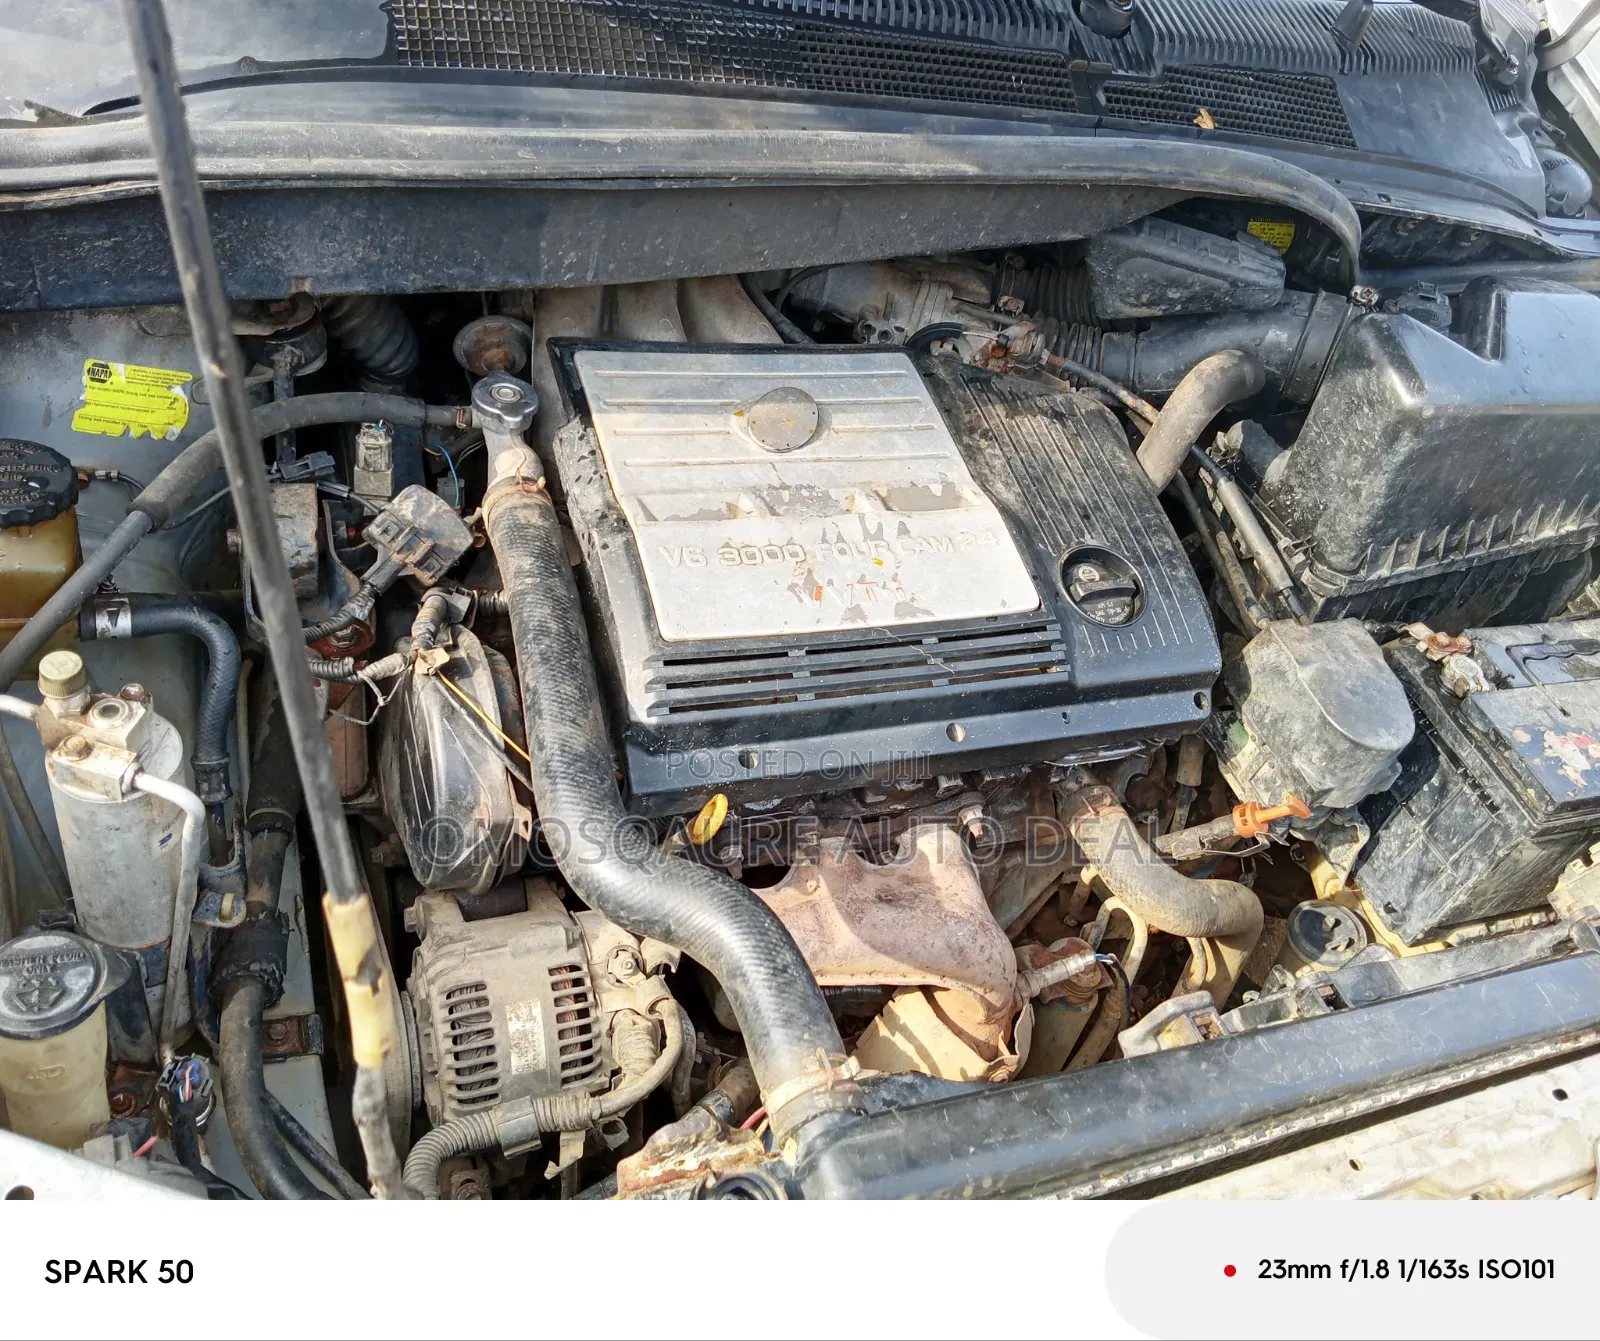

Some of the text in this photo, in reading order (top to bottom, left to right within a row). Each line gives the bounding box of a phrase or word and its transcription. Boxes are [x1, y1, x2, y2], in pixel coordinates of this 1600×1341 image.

[90, 367, 110, 379] NAPA
[659, 528, 999, 567] V6 3000 FOUR CAM 24
